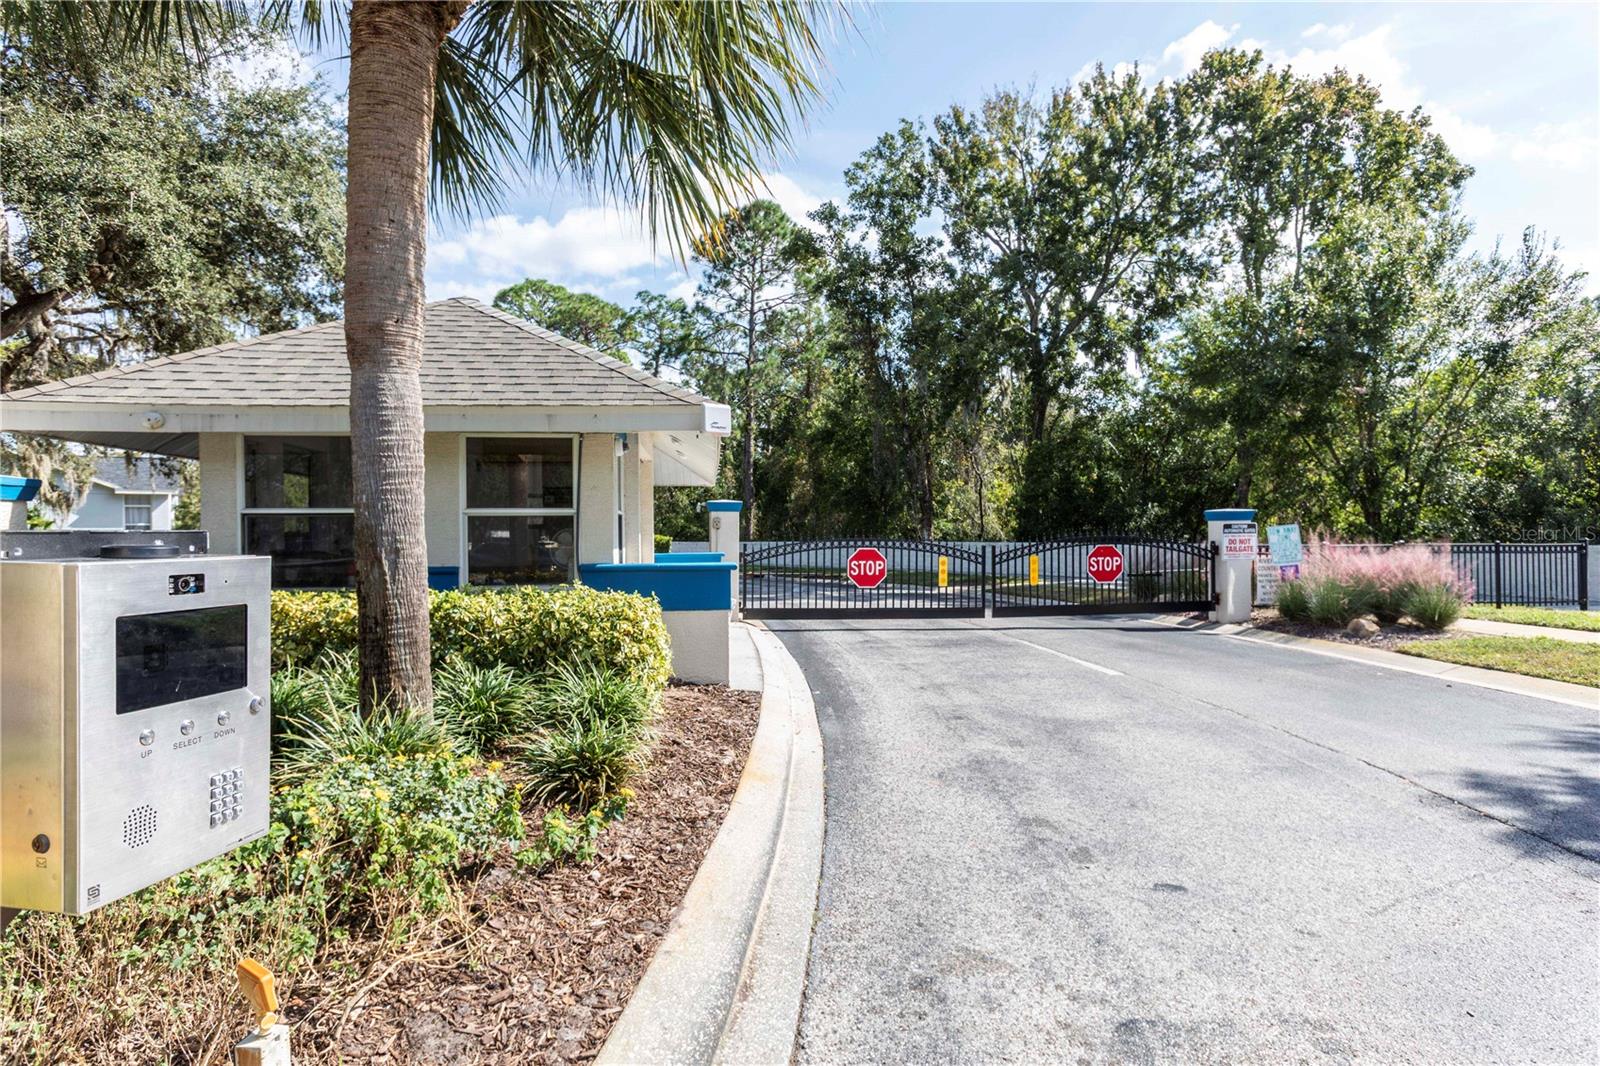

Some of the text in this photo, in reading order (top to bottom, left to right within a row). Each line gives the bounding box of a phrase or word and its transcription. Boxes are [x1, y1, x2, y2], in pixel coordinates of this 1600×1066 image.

[1225, 545, 1254, 553] TAILGATE
[850, 560, 884, 576] STOP
[1090, 557, 1121, 572] STOP
[213, 727, 236, 739] DOWN
[172, 736, 203, 750] SELECT
[140, 749, 153, 759] UP
